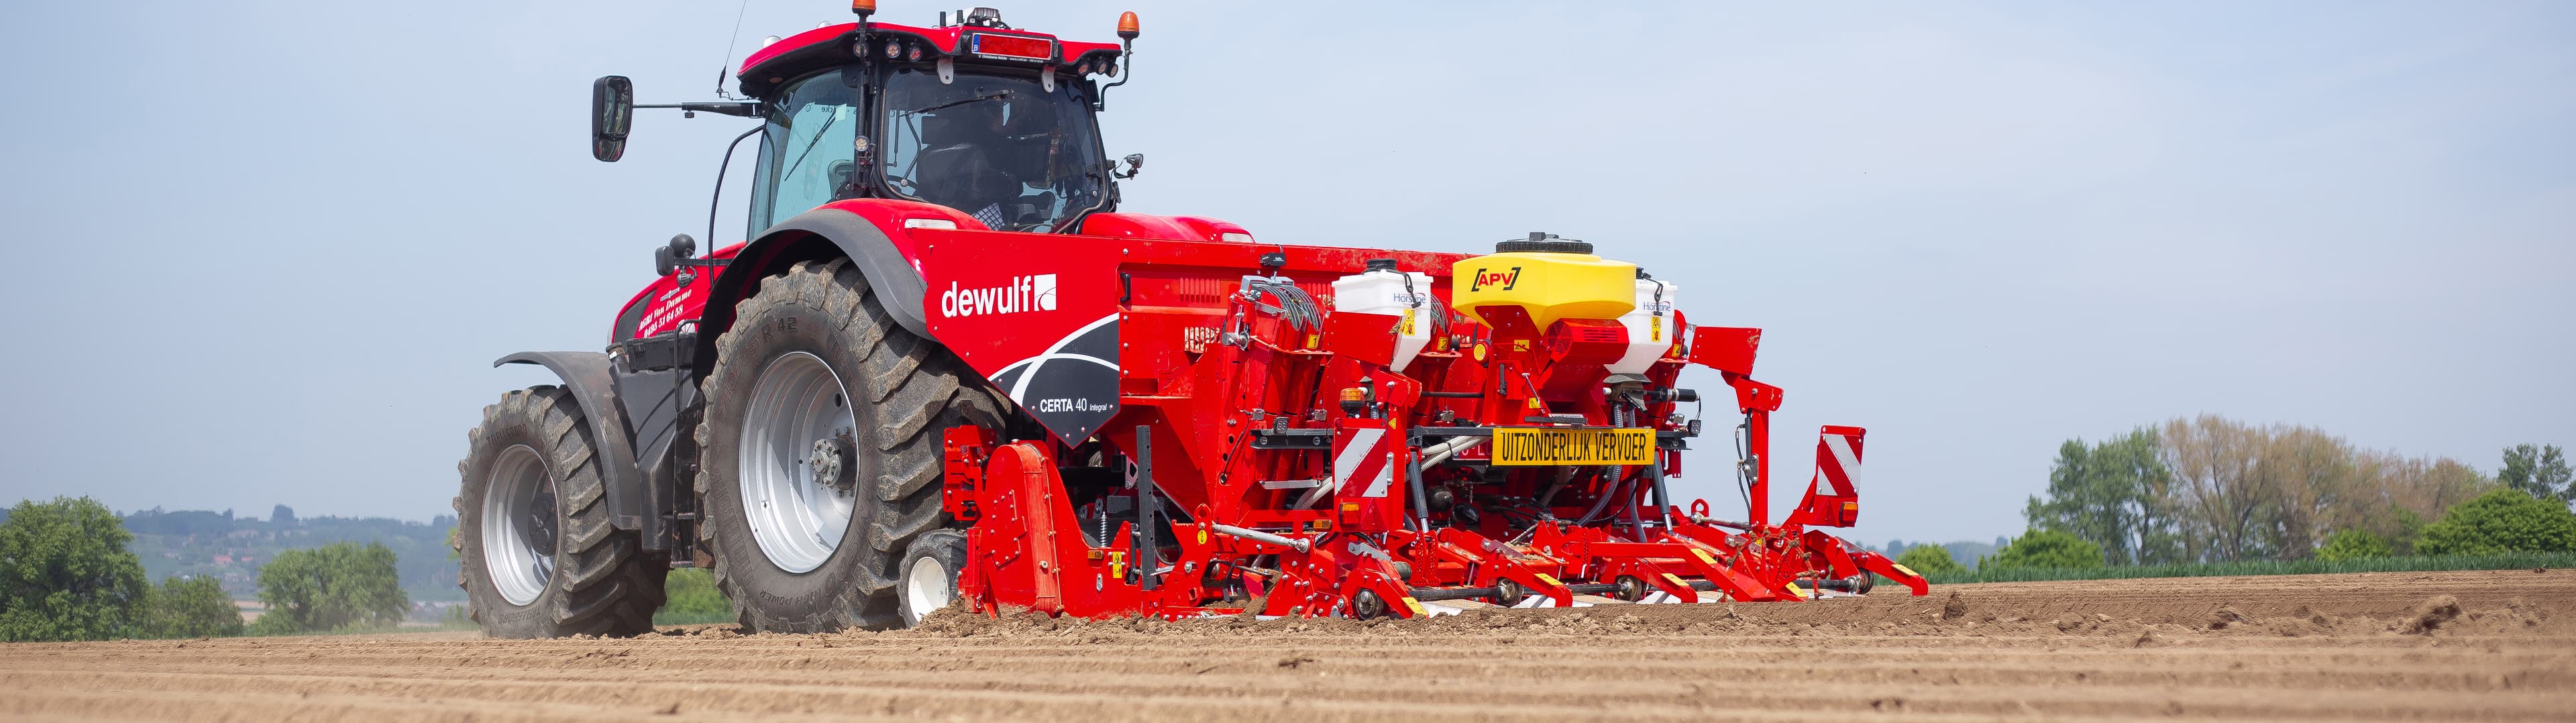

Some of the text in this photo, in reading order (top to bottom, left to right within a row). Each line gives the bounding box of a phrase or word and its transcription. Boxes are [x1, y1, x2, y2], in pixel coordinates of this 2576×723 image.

[941, 275, 1032, 318] dewulf
[1393, 293, 1426, 304] Horsine
[639, 289, 692, 332] AGRI Van Damme
[1643, 301, 1671, 312] Hortine
[643, 304, 684, 338] 0495 51 64 58
[777, 317, 799, 333] 42
[1313, 337, 1318, 347] 1
[1441, 339, 1448, 349] 2
[1040, 398, 1108, 412] CERTA 40 Integral
[1502, 432, 1591, 461] UITZONDERLIJK
[1595, 432, 1646, 461] VERVOER
[760, 588, 792, 607] POWER
